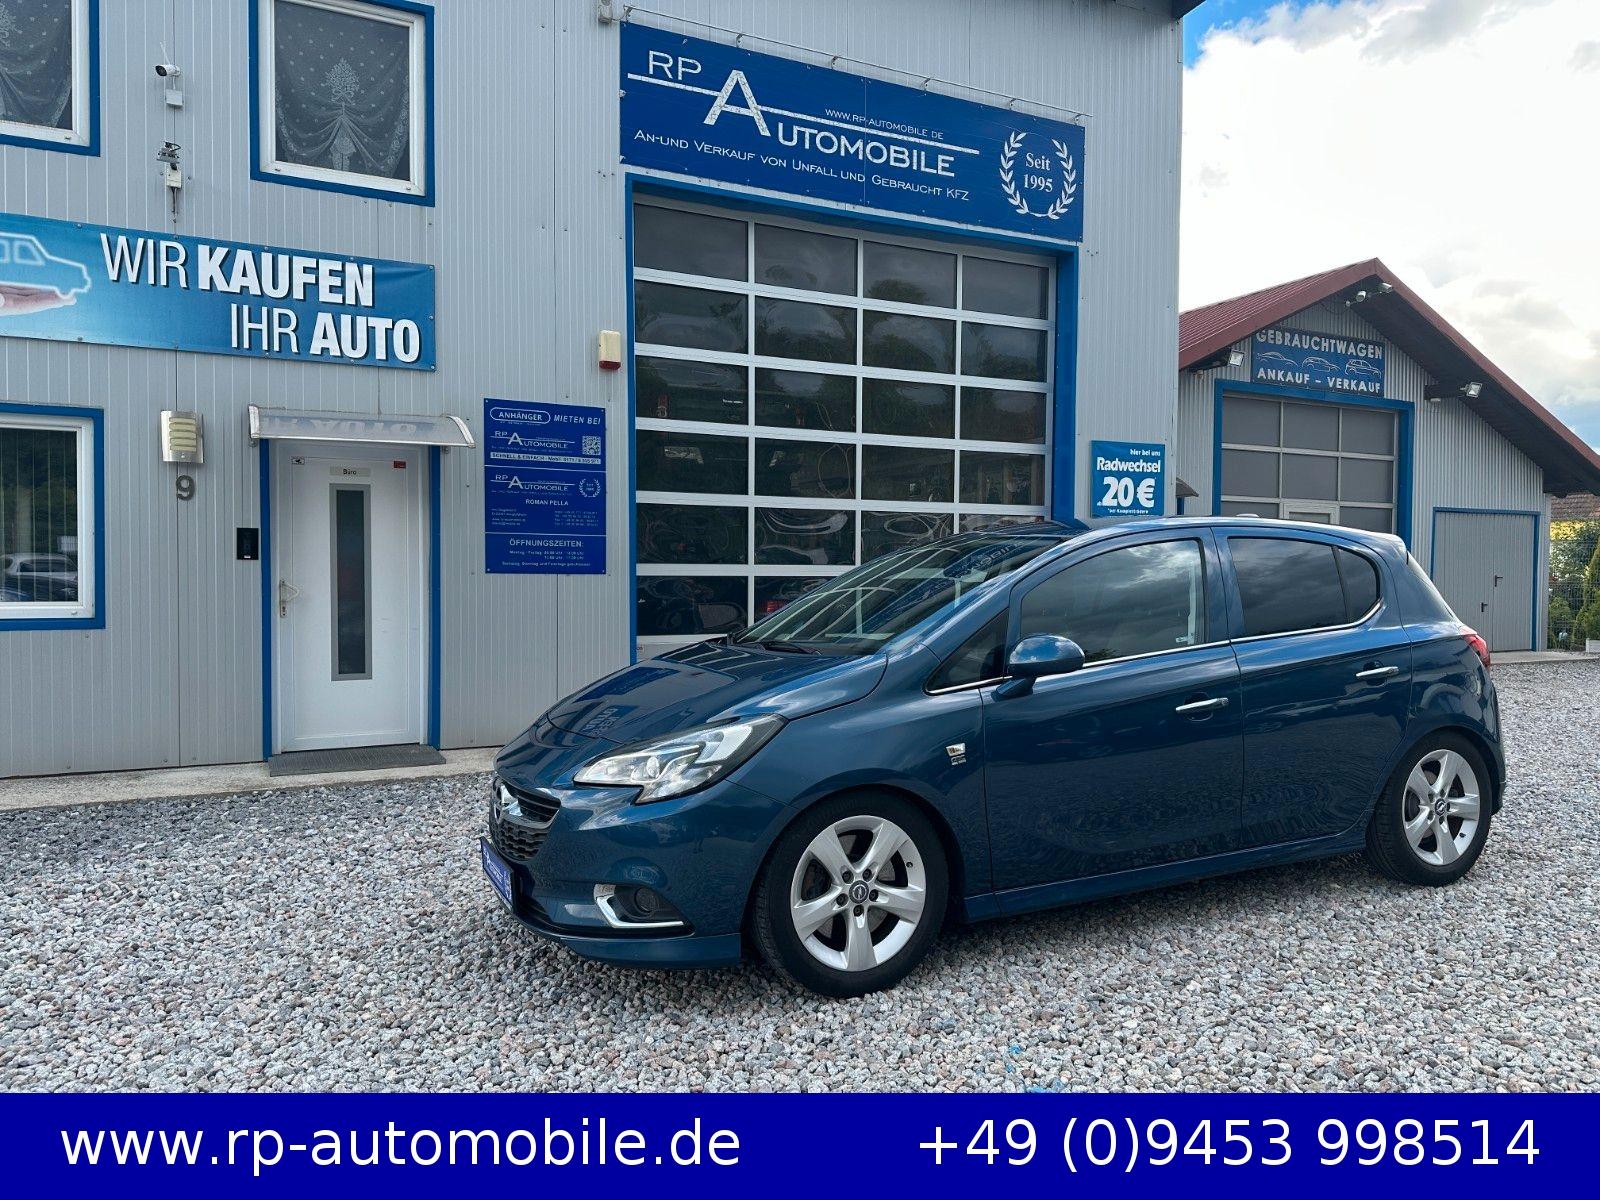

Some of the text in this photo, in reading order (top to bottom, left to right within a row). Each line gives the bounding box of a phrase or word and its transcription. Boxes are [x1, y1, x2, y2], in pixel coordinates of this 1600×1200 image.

[649, 50, 702, 81] RP
[1025, 152, 1051, 171] Seit
[1023, 174, 1053, 193] 1995
[100, 233, 373, 307] WIR KAUFEN
[231, 303, 420, 363] IHR AUTO
[1256, 329, 1383, 359] GEBRAUCHTWAGEN
[1257, 367, 1310, 384] ANKAUF
[1327, 376, 1381, 393] VERKAUF
[553, 414, 584, 423] MIETEN
[587, 417, 601, 425] BEI
[1096, 456, 1161, 473] Radwechsel
[176, 475, 195, 501] 9
